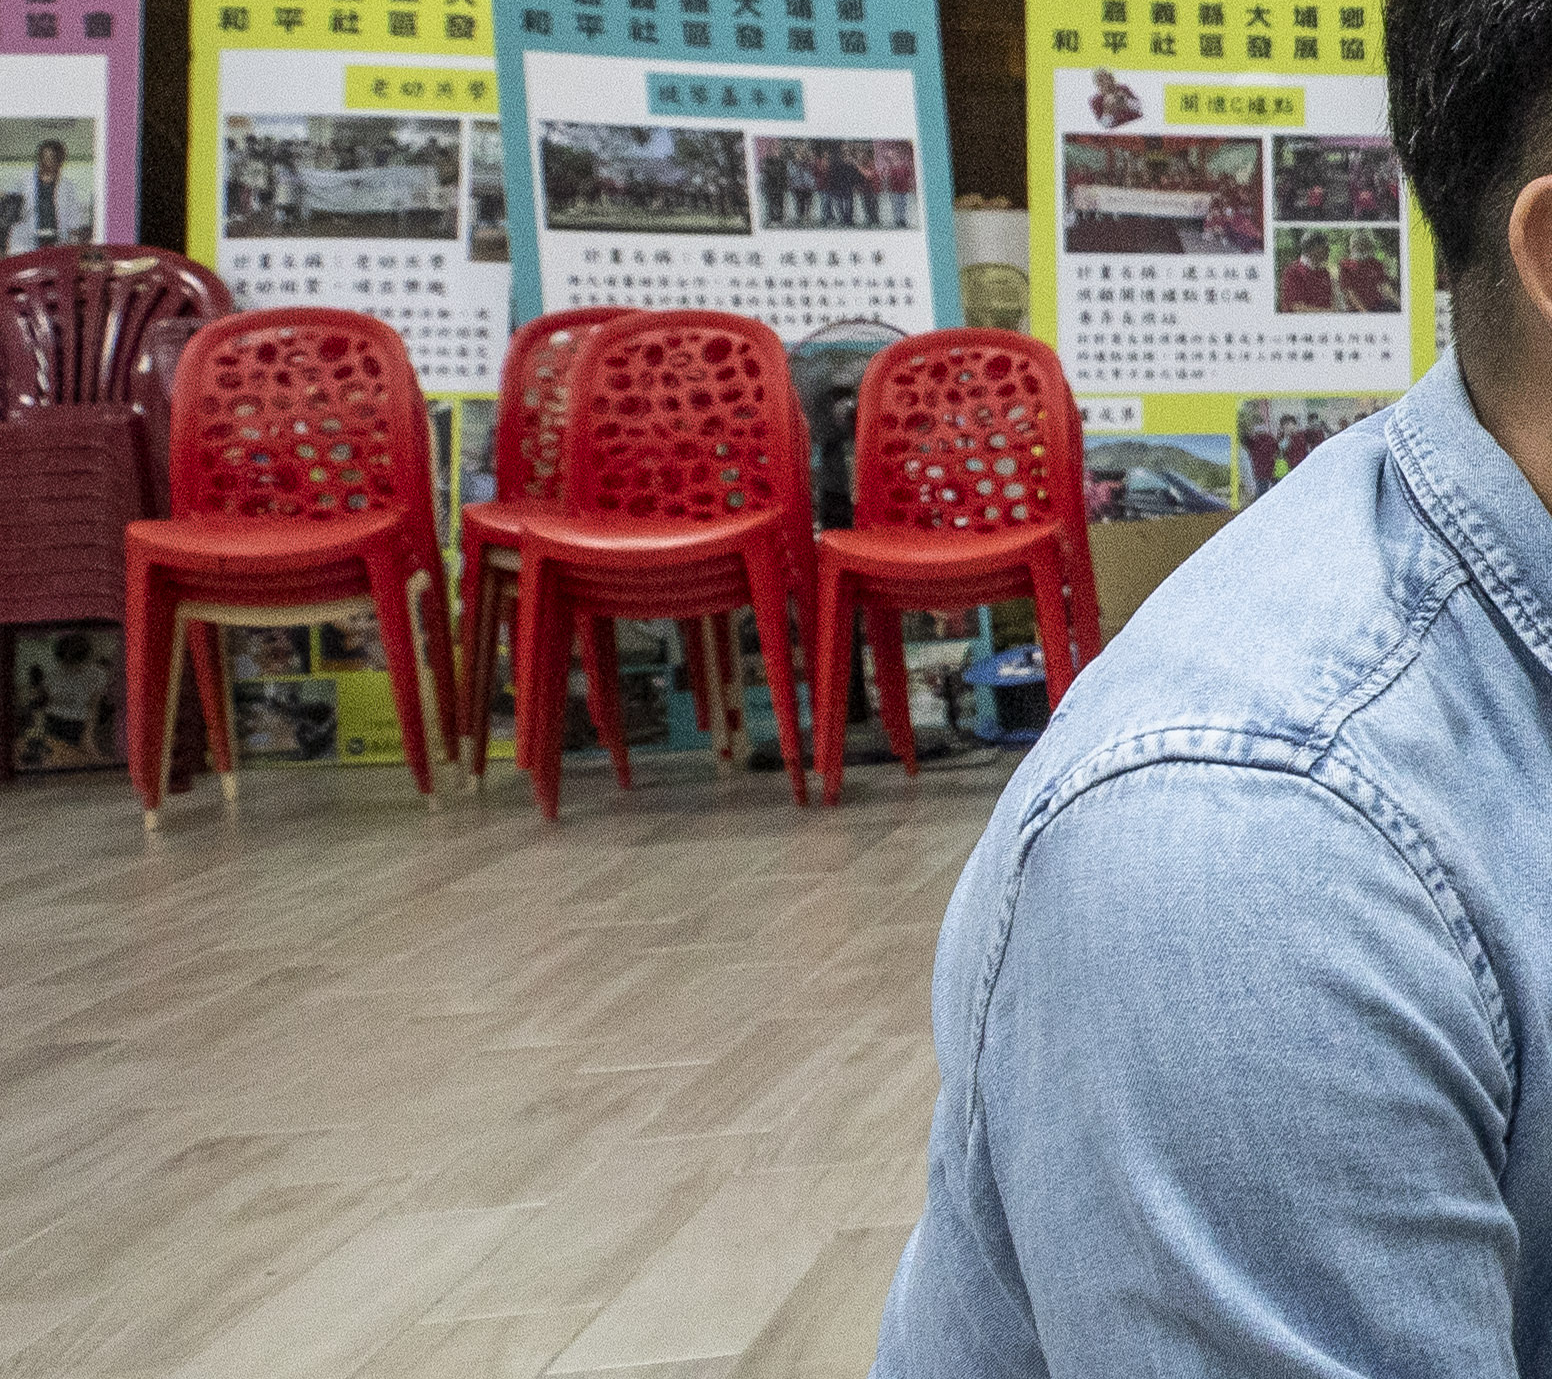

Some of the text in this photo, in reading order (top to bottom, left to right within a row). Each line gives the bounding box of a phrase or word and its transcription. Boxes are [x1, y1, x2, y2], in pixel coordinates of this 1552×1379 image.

[1053, 28, 1365, 61] 和平社區發展協
